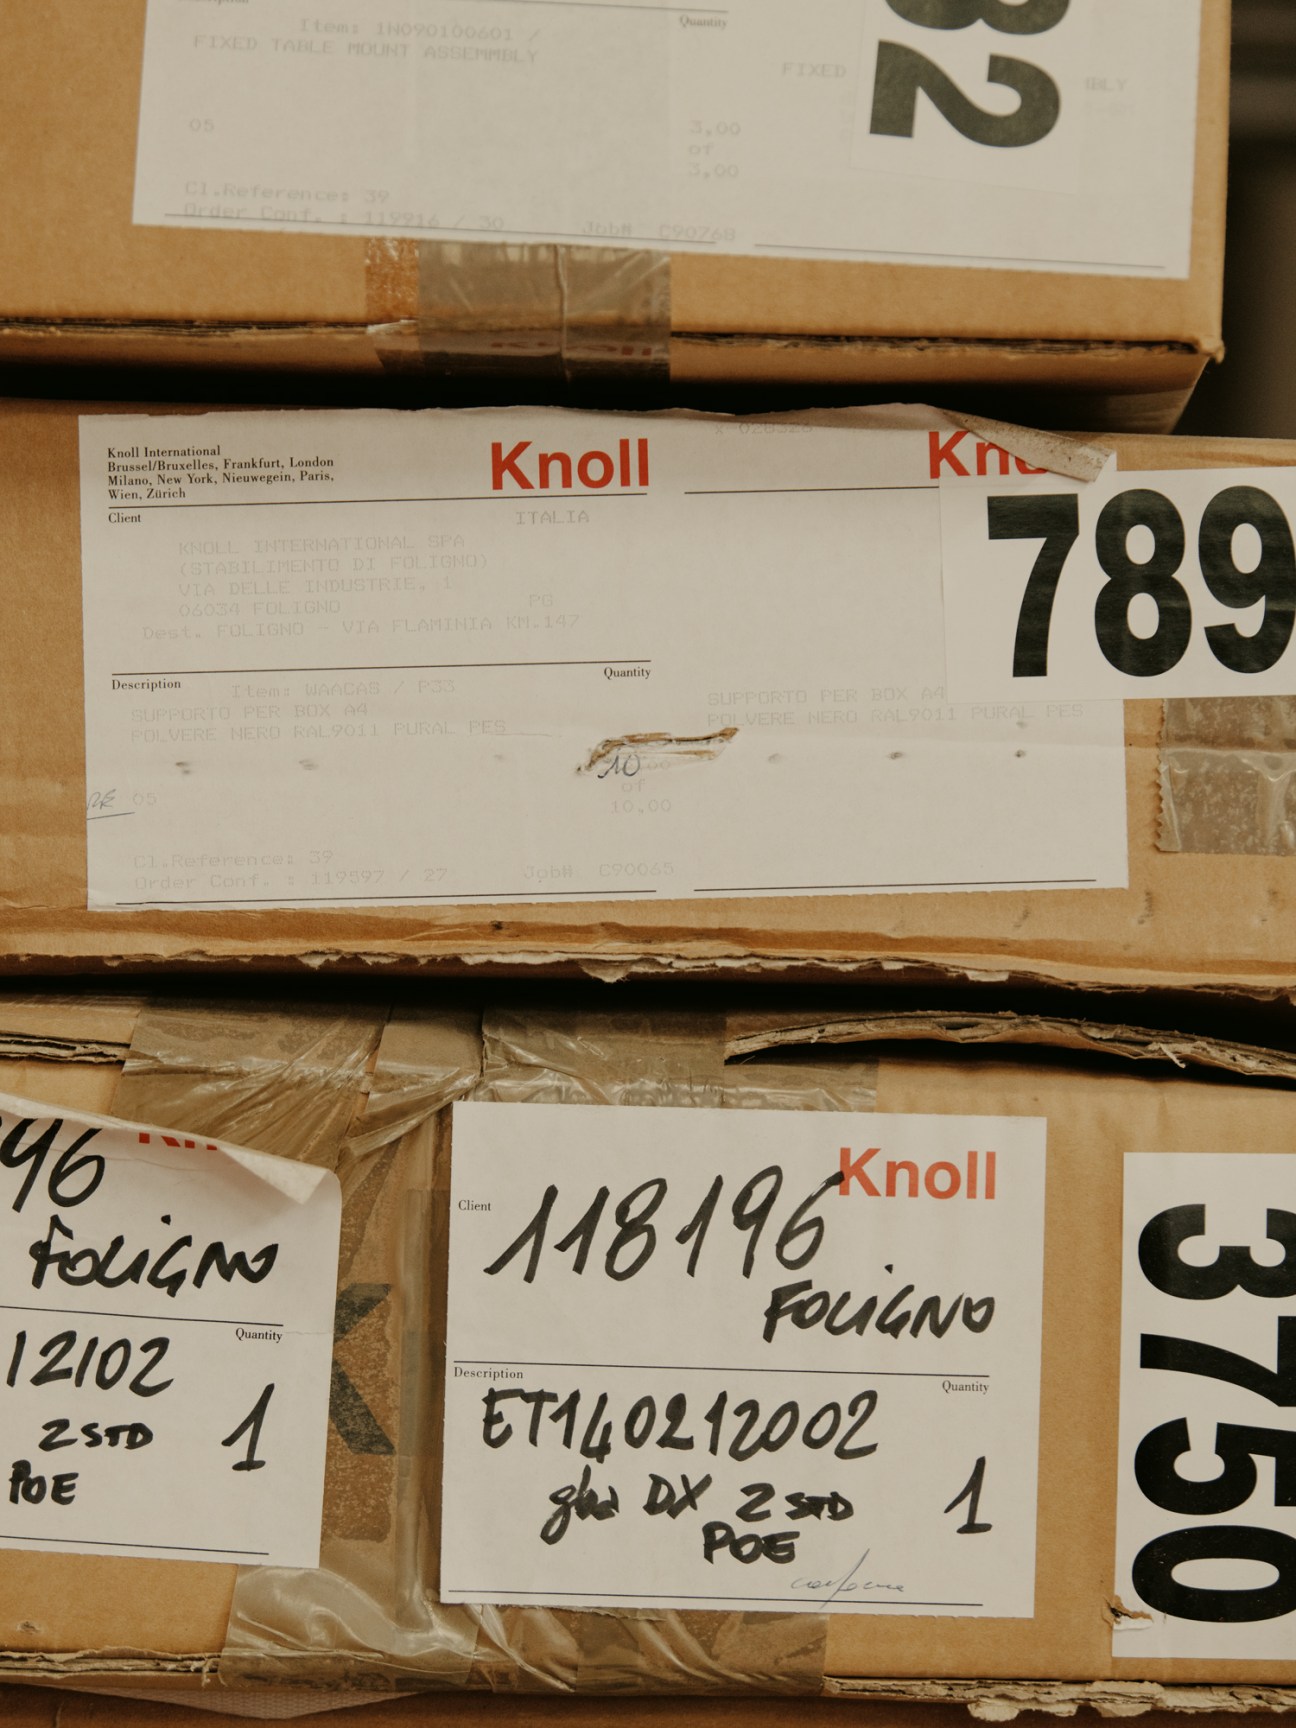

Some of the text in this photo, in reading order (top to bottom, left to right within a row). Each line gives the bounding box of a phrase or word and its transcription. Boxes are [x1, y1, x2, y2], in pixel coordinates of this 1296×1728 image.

[679, 15, 728, 30] Quantity
[193, 35, 258, 50] FIXED
[271, 38, 334, 54] TABLE
[347, 41, 411, 58] MOUNT
[781, 62, 847, 79] FIXED
[364, 191, 392, 205] 39
[107, 445, 221, 459] Knoll International
[107, 456, 334, 473] Brussel/Bruxelles, Frankfurt, London
[491, 438, 649, 491] Knoll
[107, 470, 335, 486] Milano, New York, Nieuwegein, Paris,
[108, 487, 186, 500] Wien, Zürich
[108, 512, 142, 524] Client
[515, 510, 590, 526] ITALIA
[179, 534, 466, 556] KNOLL INTERNATIONAL SPA
[353, 557, 376, 572] DI
[178, 582, 216, 598] VIA
[229, 580, 290, 596] DELLE
[254, 600, 341, 616] FOLIGNO
[529, 593, 554, 608] PG
[218, 621, 304, 638] FOLIGNO
[343, 619, 380, 635] VIA
[392, 616, 493, 634] FLAMINIA
[603, 664, 651, 679] Quantity
[111, 677, 182, 692] Description
[707, 689, 808, 706] SUPPORTO
[821, 688, 857, 703] PER
[871, 687, 907, 701] BOX
[131, 700, 368, 722] SUPPORTO PER BOX A4
[708, 710, 795, 727] POLVERE
[808, 709, 857, 724] NERO
[972, 705, 1035, 720] PURAL
[1047, 704, 1083, 718] PES
[131, 727, 217, 744] POLVERE
[231, 725, 280, 741] NERO
[394, 720, 456, 736] PURAL
[469, 719, 506, 734] PES
[309, 851, 333, 865] 39
[135, 875, 196, 890] Order
[423, 868, 447, 882] 27
[838, 1147, 996, 1200] Knoll
[458, 1199, 492, 1213] Client
[484, 1165, 845, 1283] 118196
[235, 1327, 283, 1343] Quantity
[453, 1366, 524, 1380] Description
[941, 1379, 990, 1395] Quantity
[943, 1455, 993, 1534] 1
